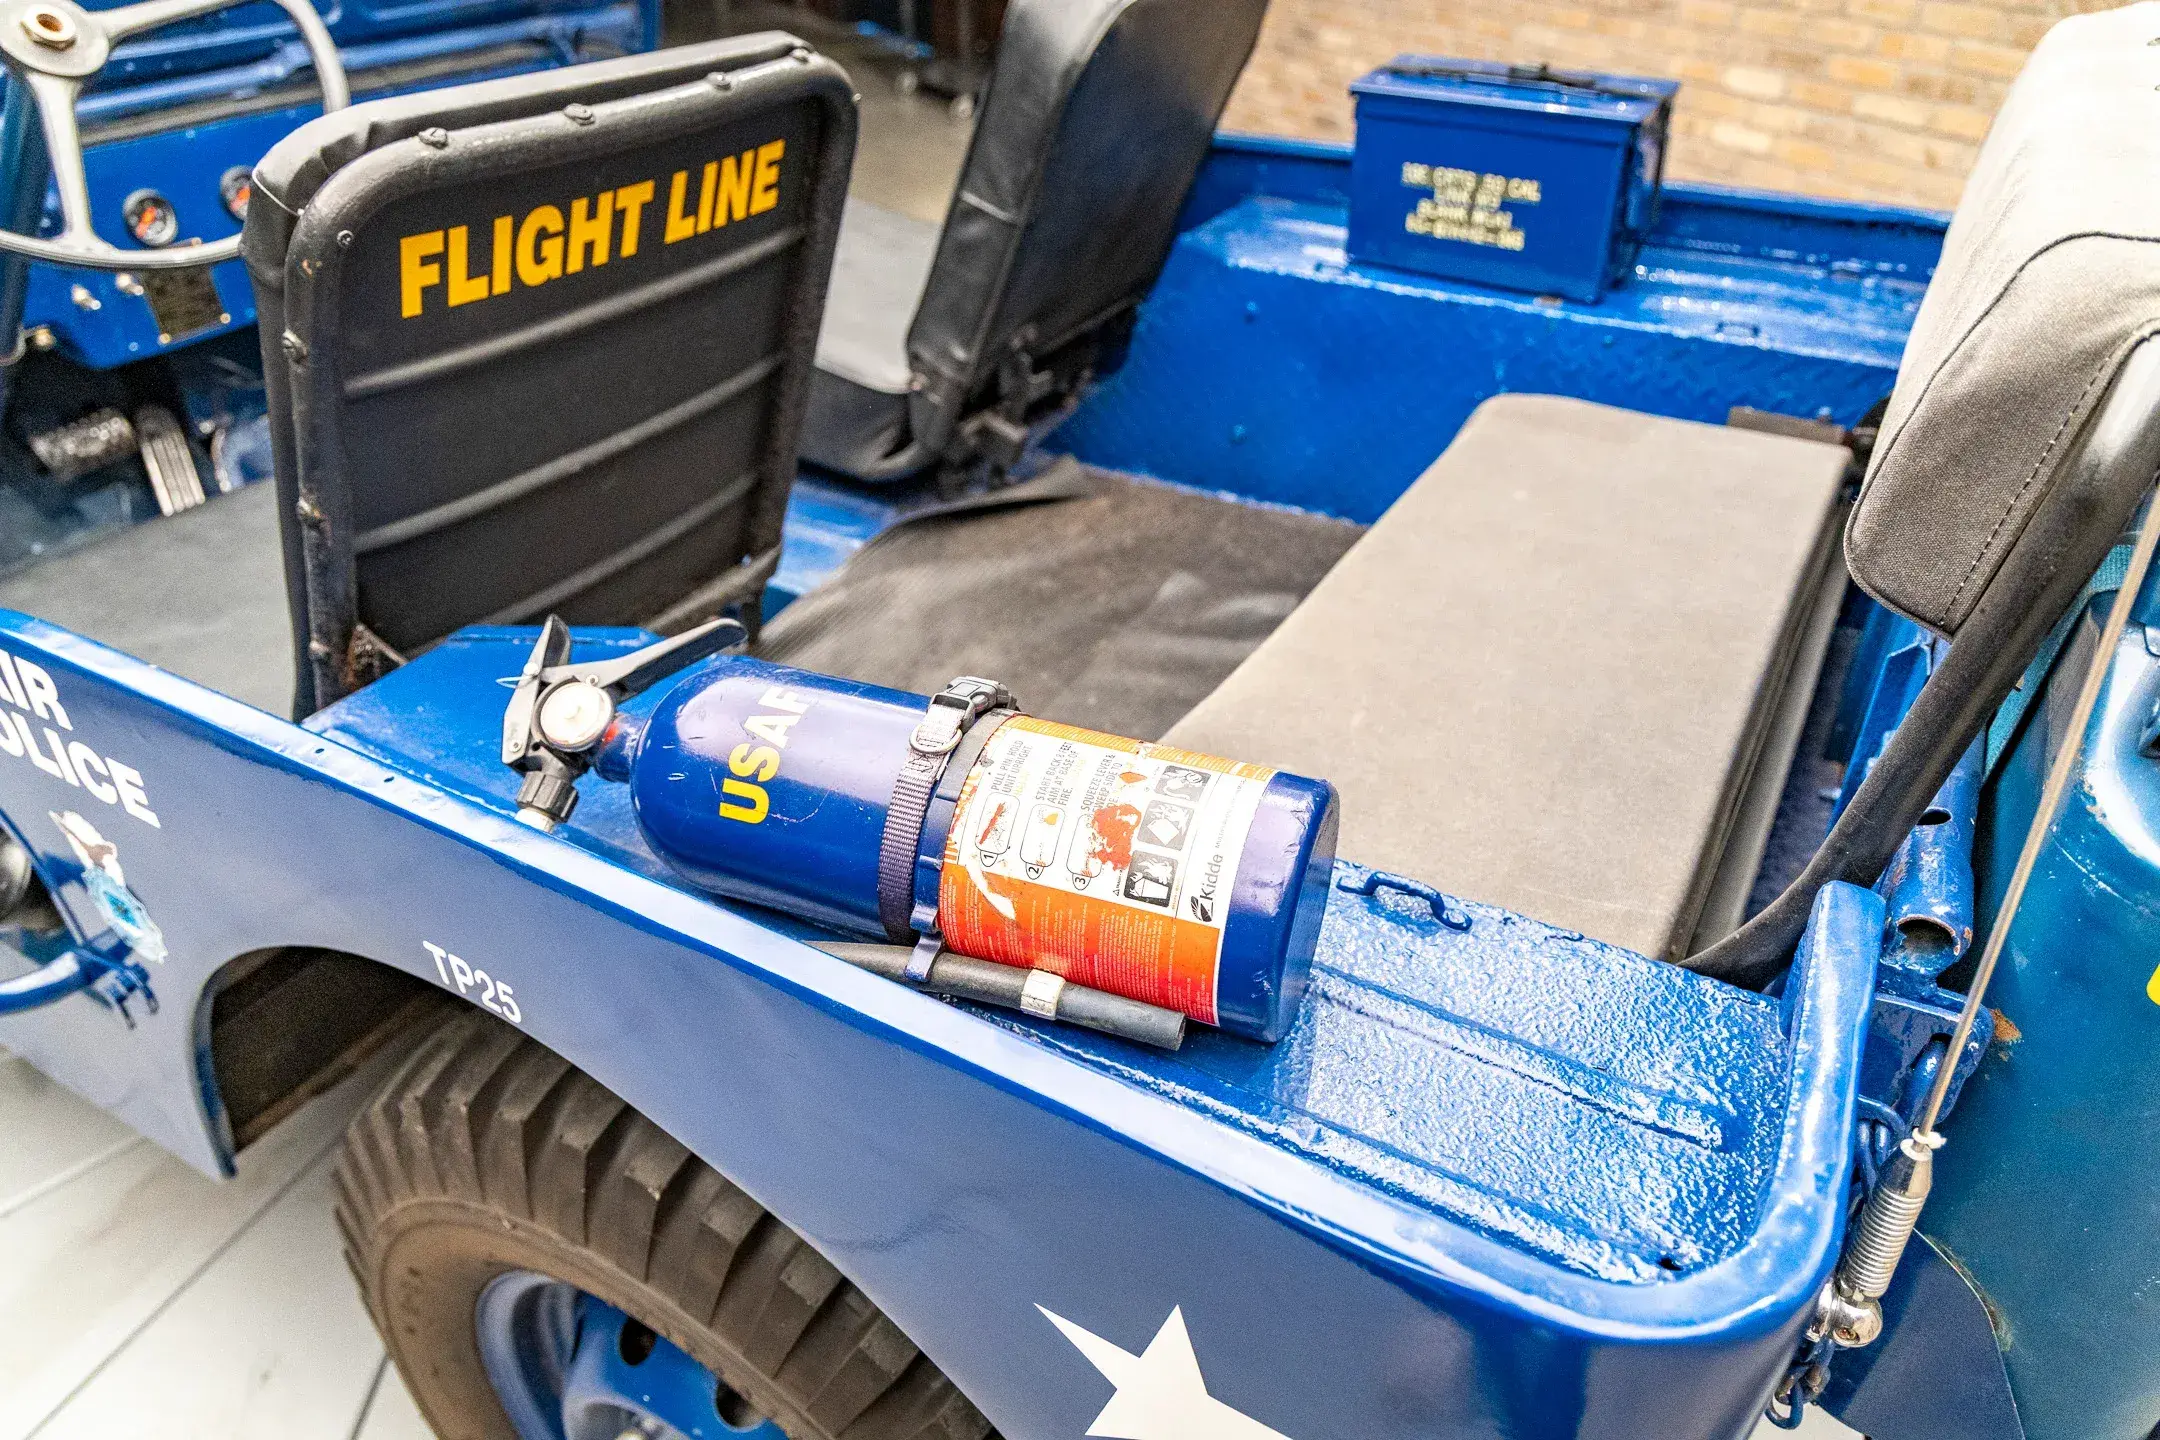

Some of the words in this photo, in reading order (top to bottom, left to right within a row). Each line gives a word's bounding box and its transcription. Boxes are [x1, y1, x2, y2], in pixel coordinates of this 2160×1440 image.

[400, 180, 655, 319] FLIGHT
[664, 138, 786, 245] LINE
[718, 685, 813, 824] USAF
[990, 771, 1006, 790] PULL
[1006, 739, 1023, 756] HOLD
[1058, 758, 1074, 775] BASE
[1001, 774, 1016, 793] UNIT
[1035, 776, 1051, 800] START
[1045, 757, 1062, 775] BACK
[1054, 775, 1064, 785] AT
[1080, 777, 1101, 811] SQUEEZE
[1094, 757, 1112, 777] LEVER
[1102, 770, 1117, 786] SIDE
[1110, 761, 1122, 769] TO
[1046, 786, 1060, 803] AIM
[1057, 785, 1073, 805] FIRE.
[1029, 866, 1039, 874] 2
[1075, 877, 1086, 885] 3
[1200, 854, 1223, 900] Kidde
[423, 941, 521, 1023] TP25
